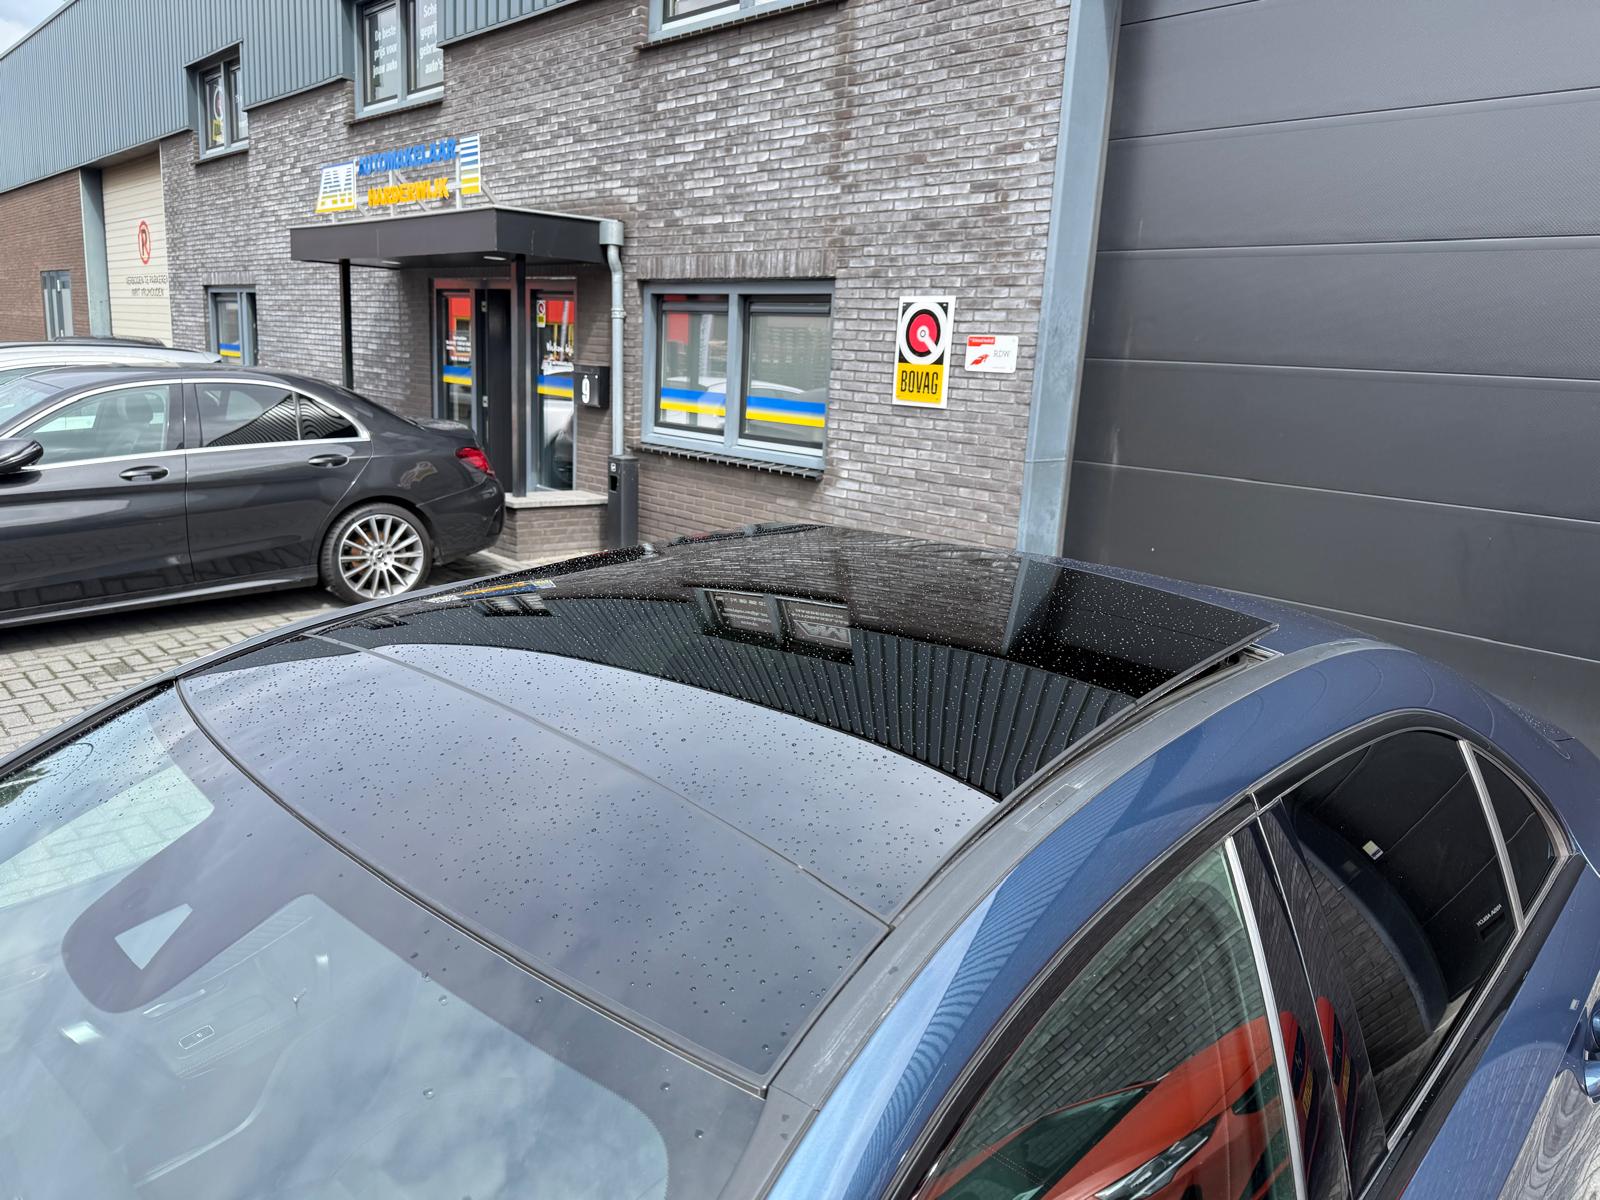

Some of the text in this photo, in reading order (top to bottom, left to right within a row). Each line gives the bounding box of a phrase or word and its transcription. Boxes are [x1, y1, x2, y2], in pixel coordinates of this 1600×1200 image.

[358, 137, 457, 177] AUTOMAKELAAR
[368, 177, 449, 207] HARDERWIJK
[900, 370, 939, 395] BOVAG
